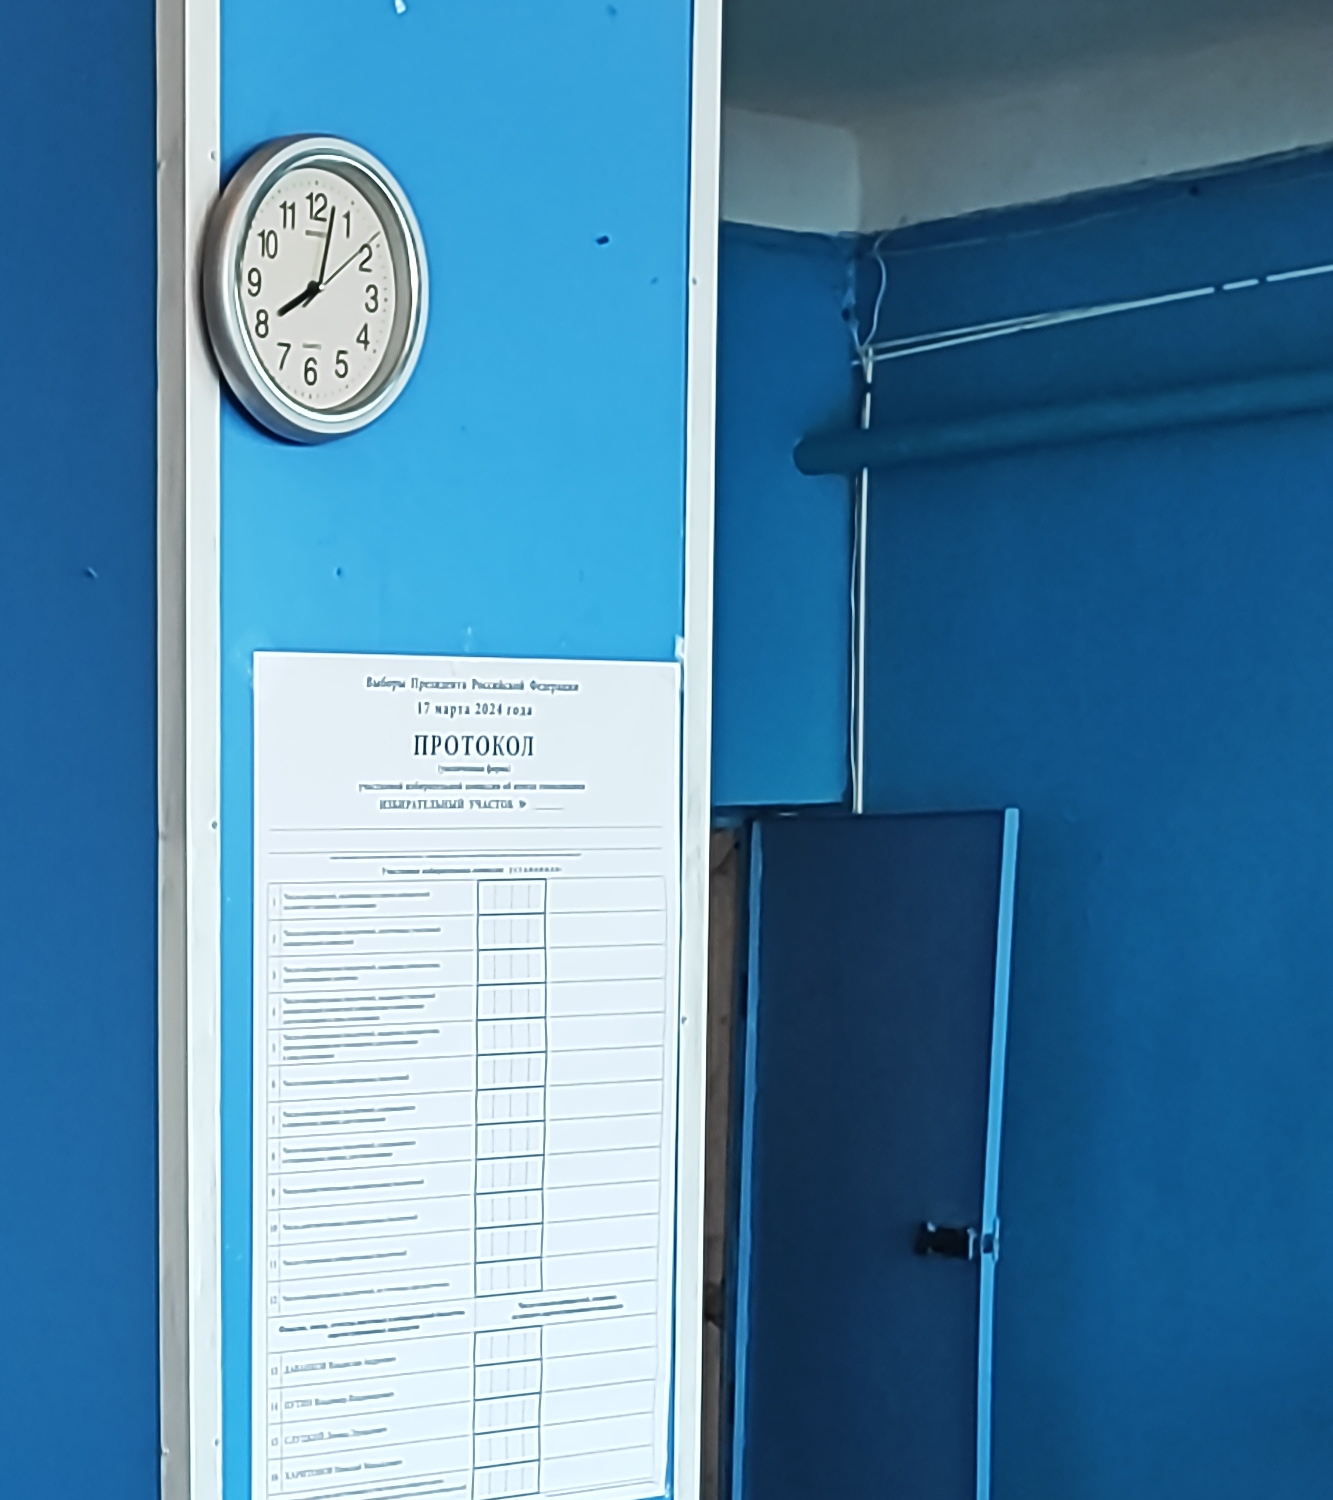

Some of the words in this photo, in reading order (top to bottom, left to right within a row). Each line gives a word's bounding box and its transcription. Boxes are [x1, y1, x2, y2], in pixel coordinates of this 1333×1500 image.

[280, 200, 296, 230] 11
[305, 192, 328, 222] 12
[342, 210, 351, 239] 1
[257, 229, 278, 259] 10
[358, 243, 373, 273] 2
[247, 267, 262, 297] 9
[365, 284, 379, 313] 3
[255, 309, 269, 338] 8
[356, 323, 370, 351] 4
[277, 342, 291, 371] 7
[334, 350, 348, 378] 5
[304, 357, 317, 386] 6
[418, 701, 431, 714] 17
[435, 705, 470, 718] марта
[475, 702, 502, 715] 2024
[413, 734, 534, 757] ПРОТОКОЛ
